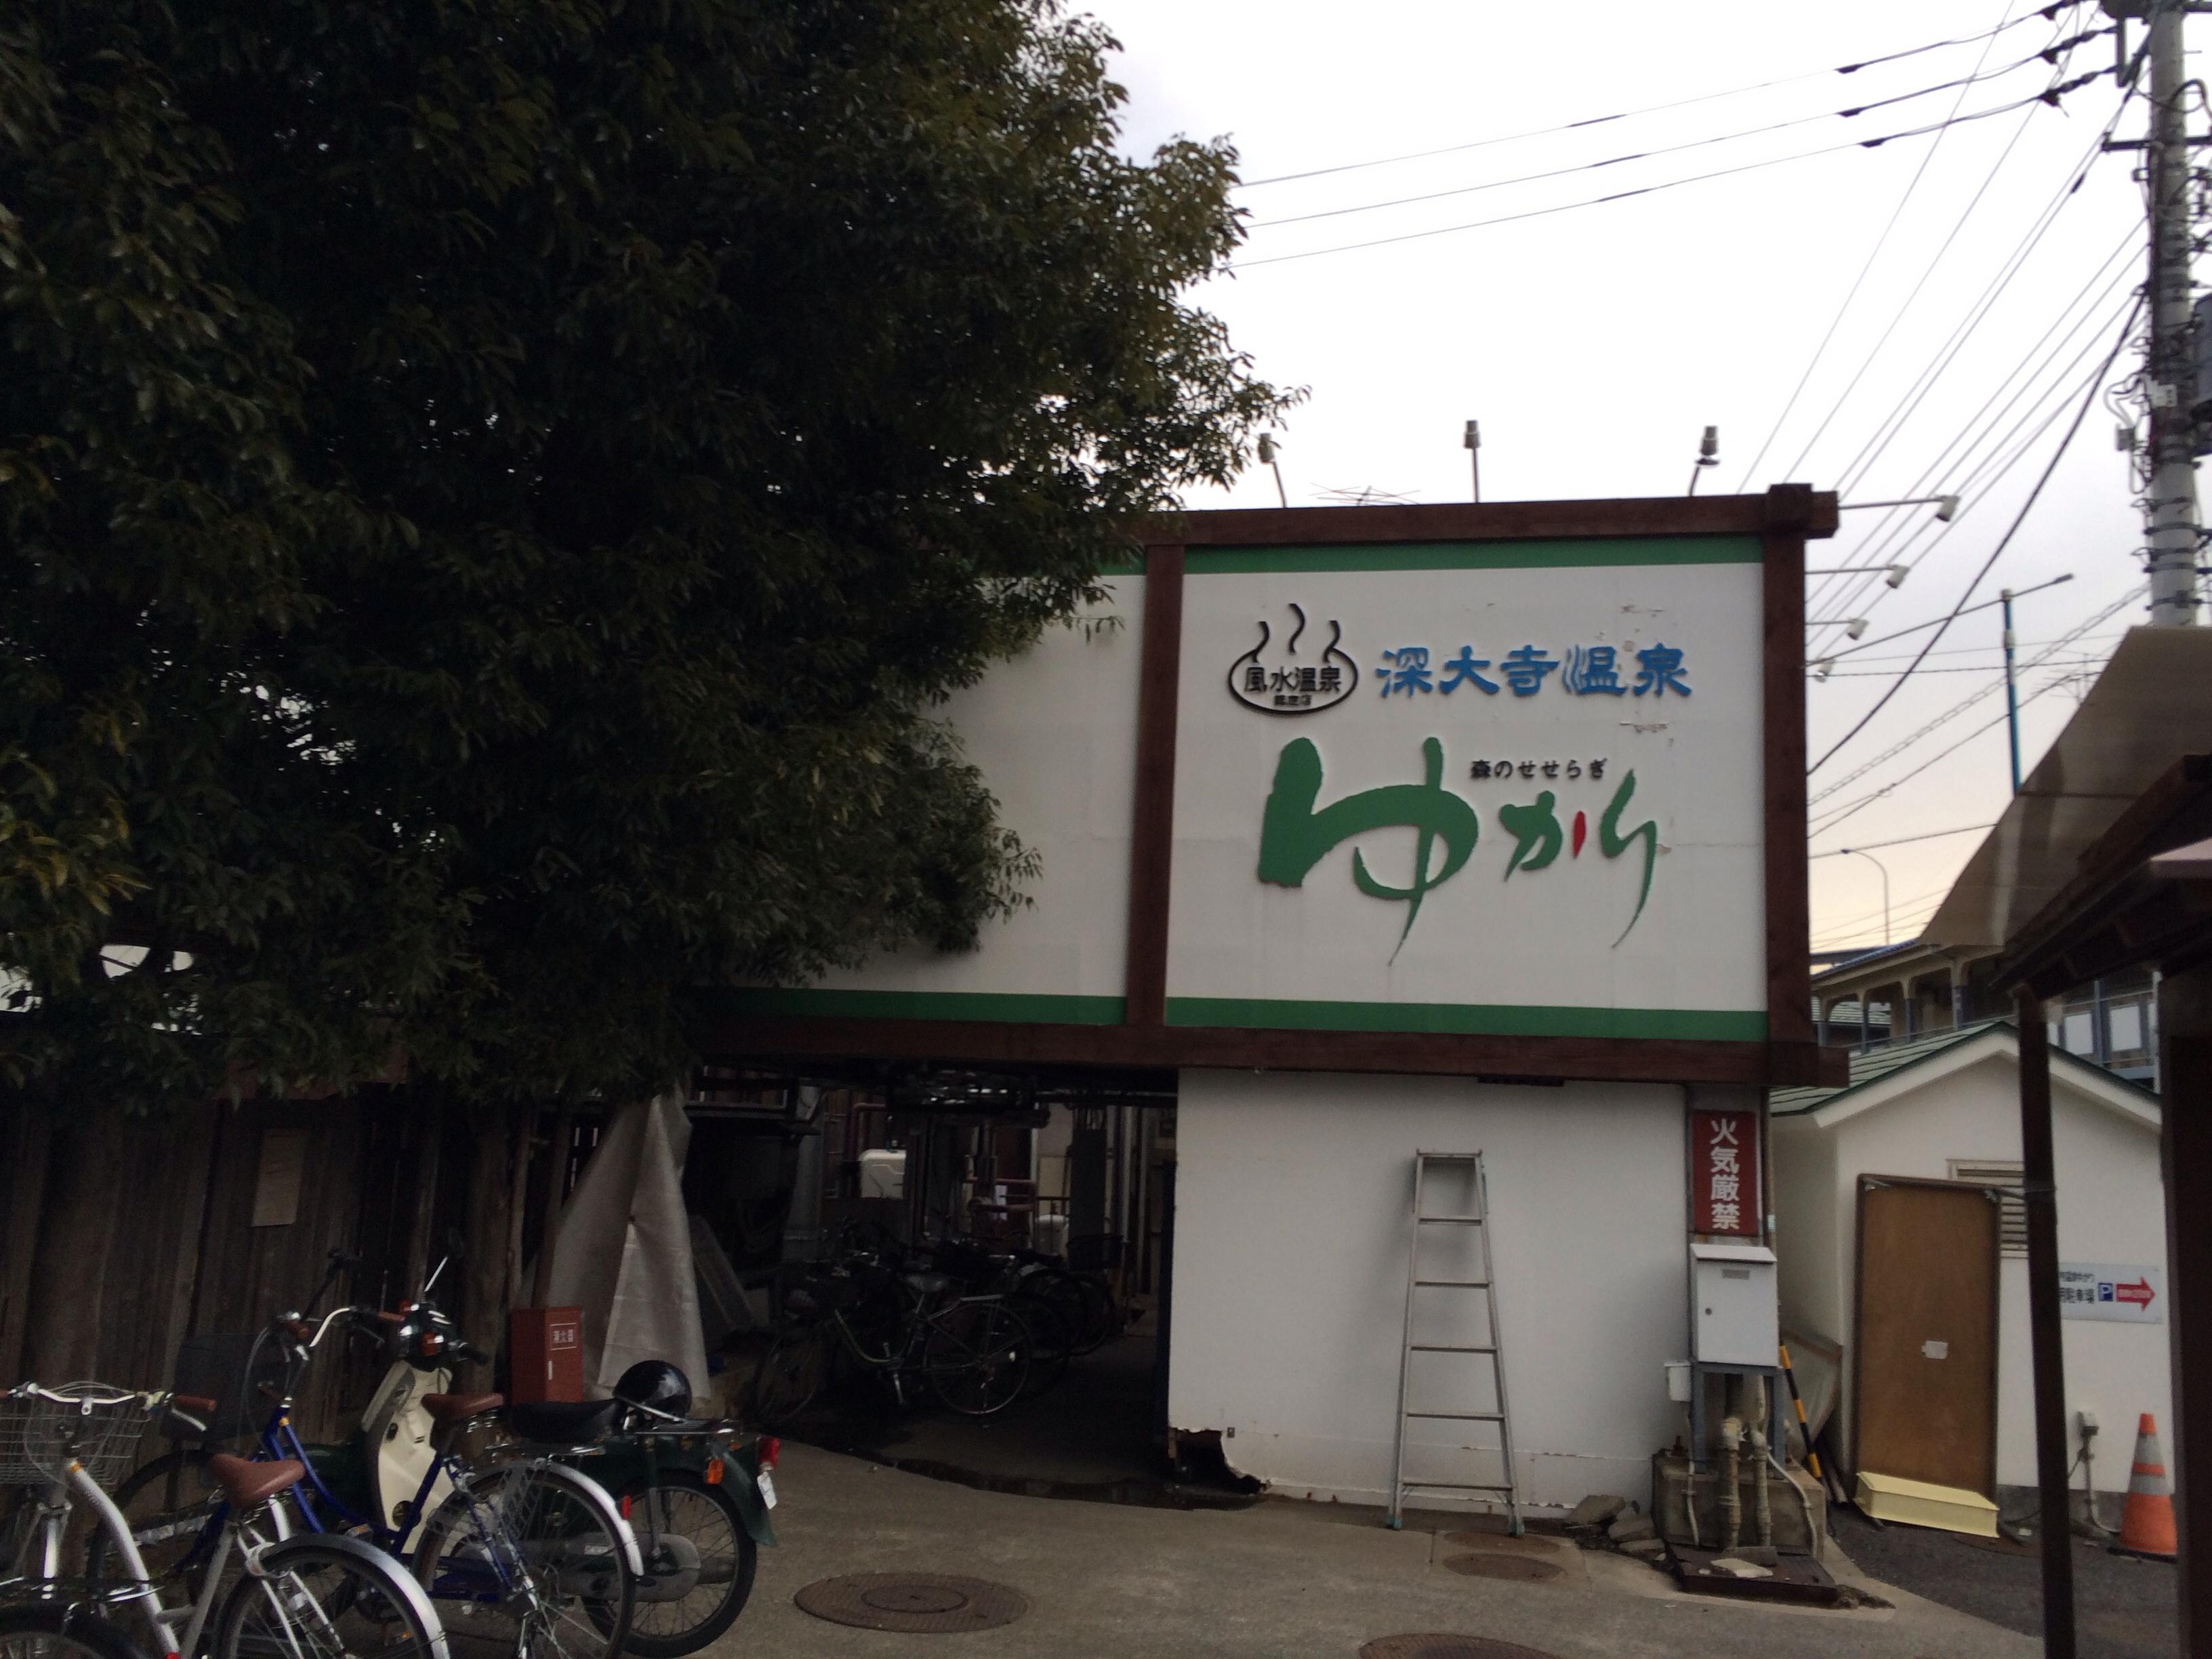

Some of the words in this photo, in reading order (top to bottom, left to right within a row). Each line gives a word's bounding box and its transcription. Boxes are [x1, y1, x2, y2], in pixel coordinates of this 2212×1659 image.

[1244, 665, 1341, 693] 風水温泉
[1375, 642, 1692, 698] 深大寺温泉
[1471, 758, 1607, 779] 森のせせらぎ
[1257, 737, 1658, 966] ゆかり
[1709, 1118, 1740, 1230] 火気厳禁
